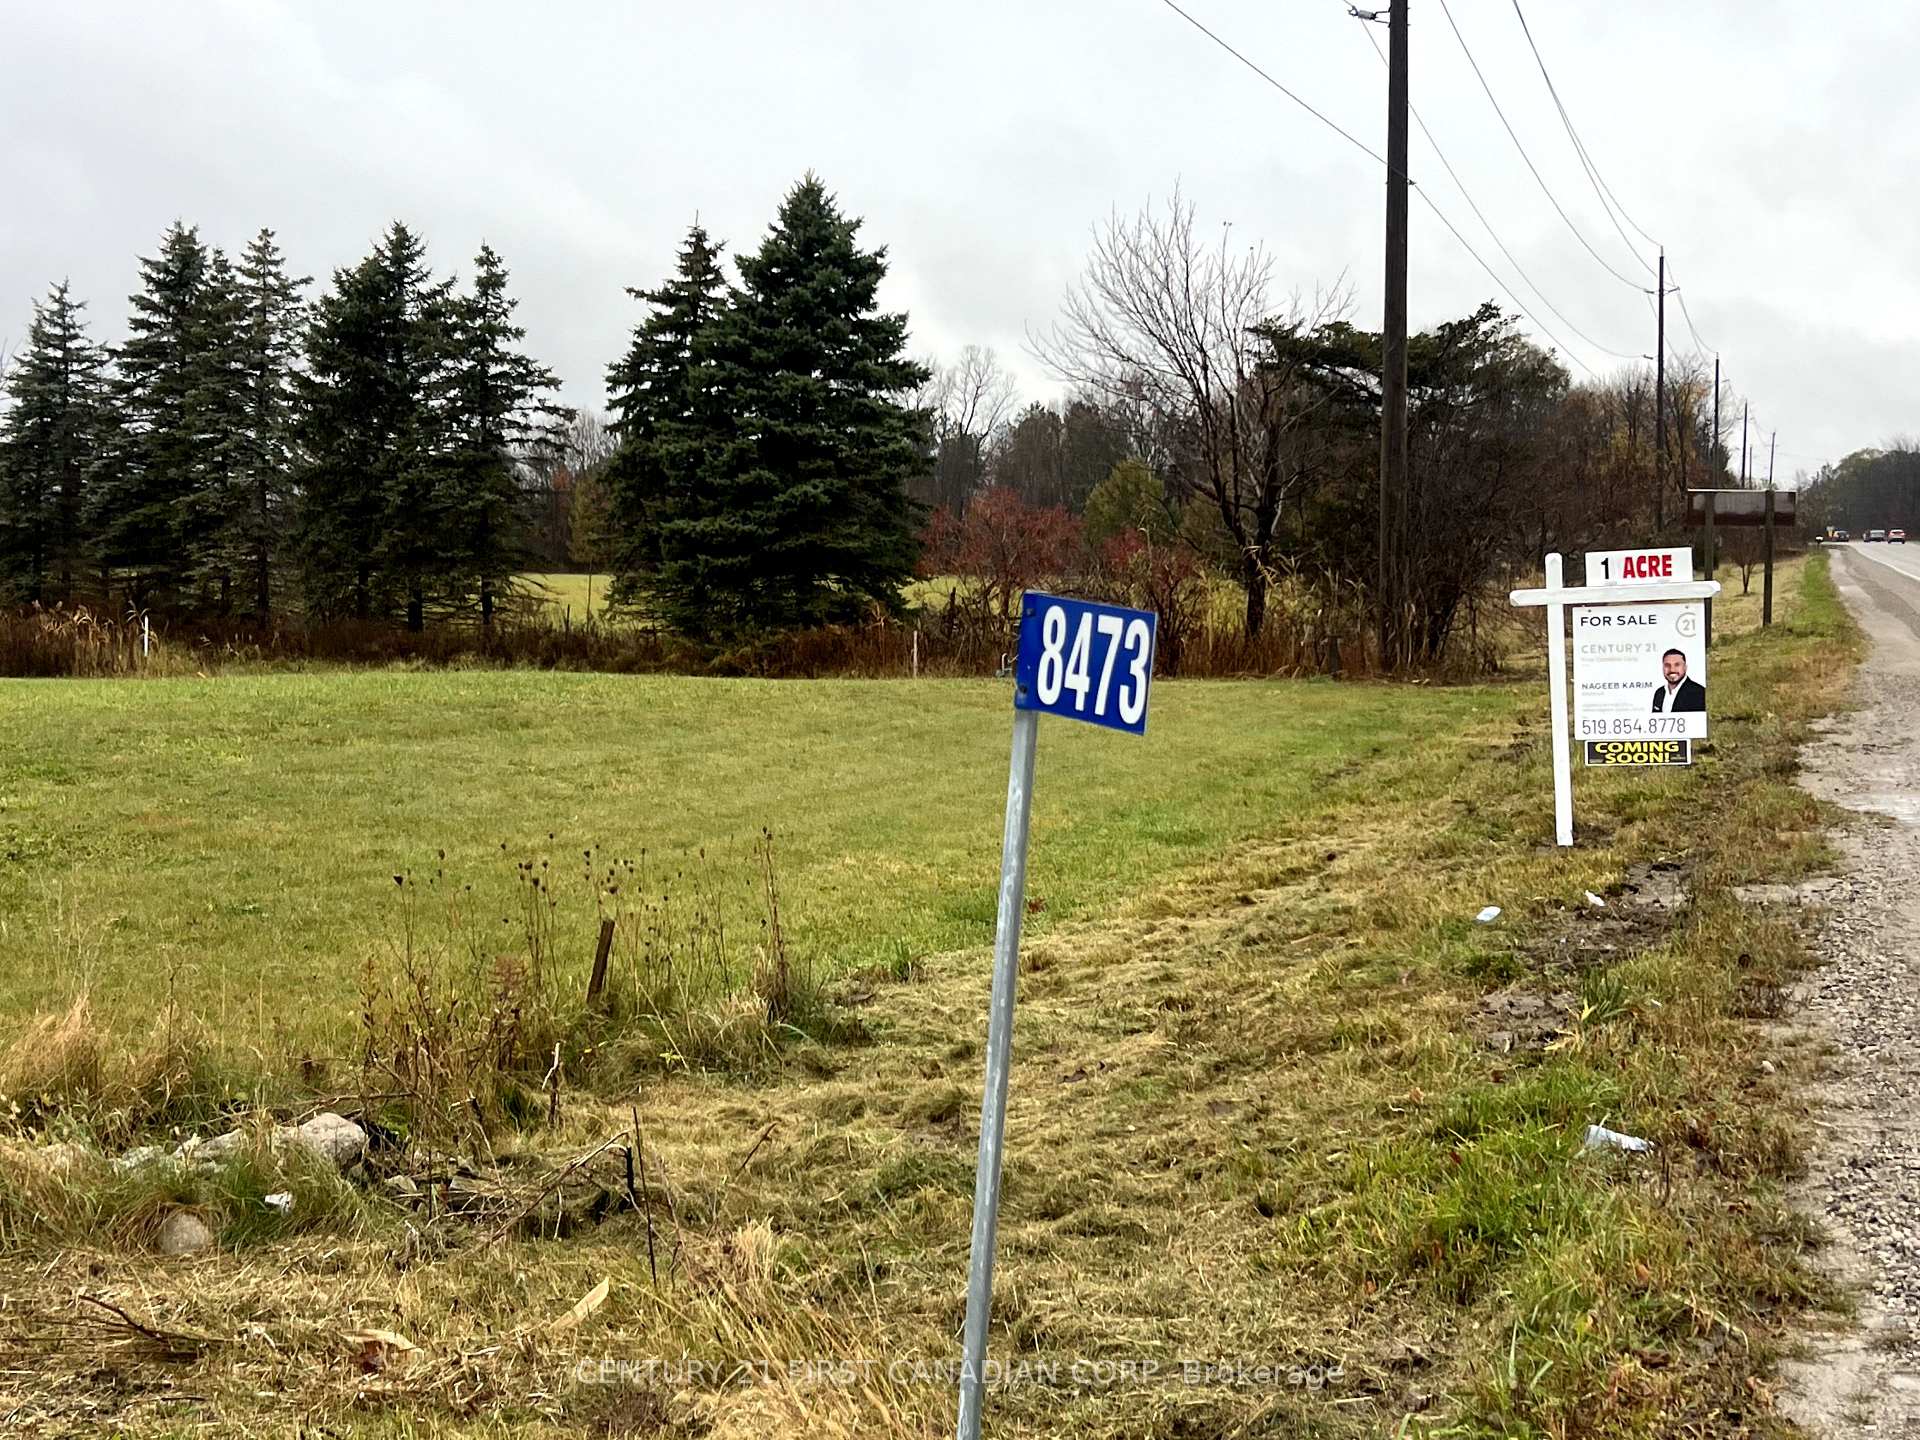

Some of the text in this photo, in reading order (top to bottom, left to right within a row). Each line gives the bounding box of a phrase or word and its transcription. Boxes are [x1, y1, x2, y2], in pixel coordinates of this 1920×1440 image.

[1600, 554, 1673, 580] 1 ACRE
[1580, 614, 1658, 627] FOR SALE
[1682, 619, 1696, 632] 21
[1581, 643, 1642, 654] CENTURY
[1037, 605, 1151, 725] 8473
[1581, 681, 1653, 690] NAGEEB KARIM
[1582, 717, 1686, 736] 519.854.8778
[1595, 741, 1680, 753] COMING
[1605, 752, 1670, 764] SOON!
